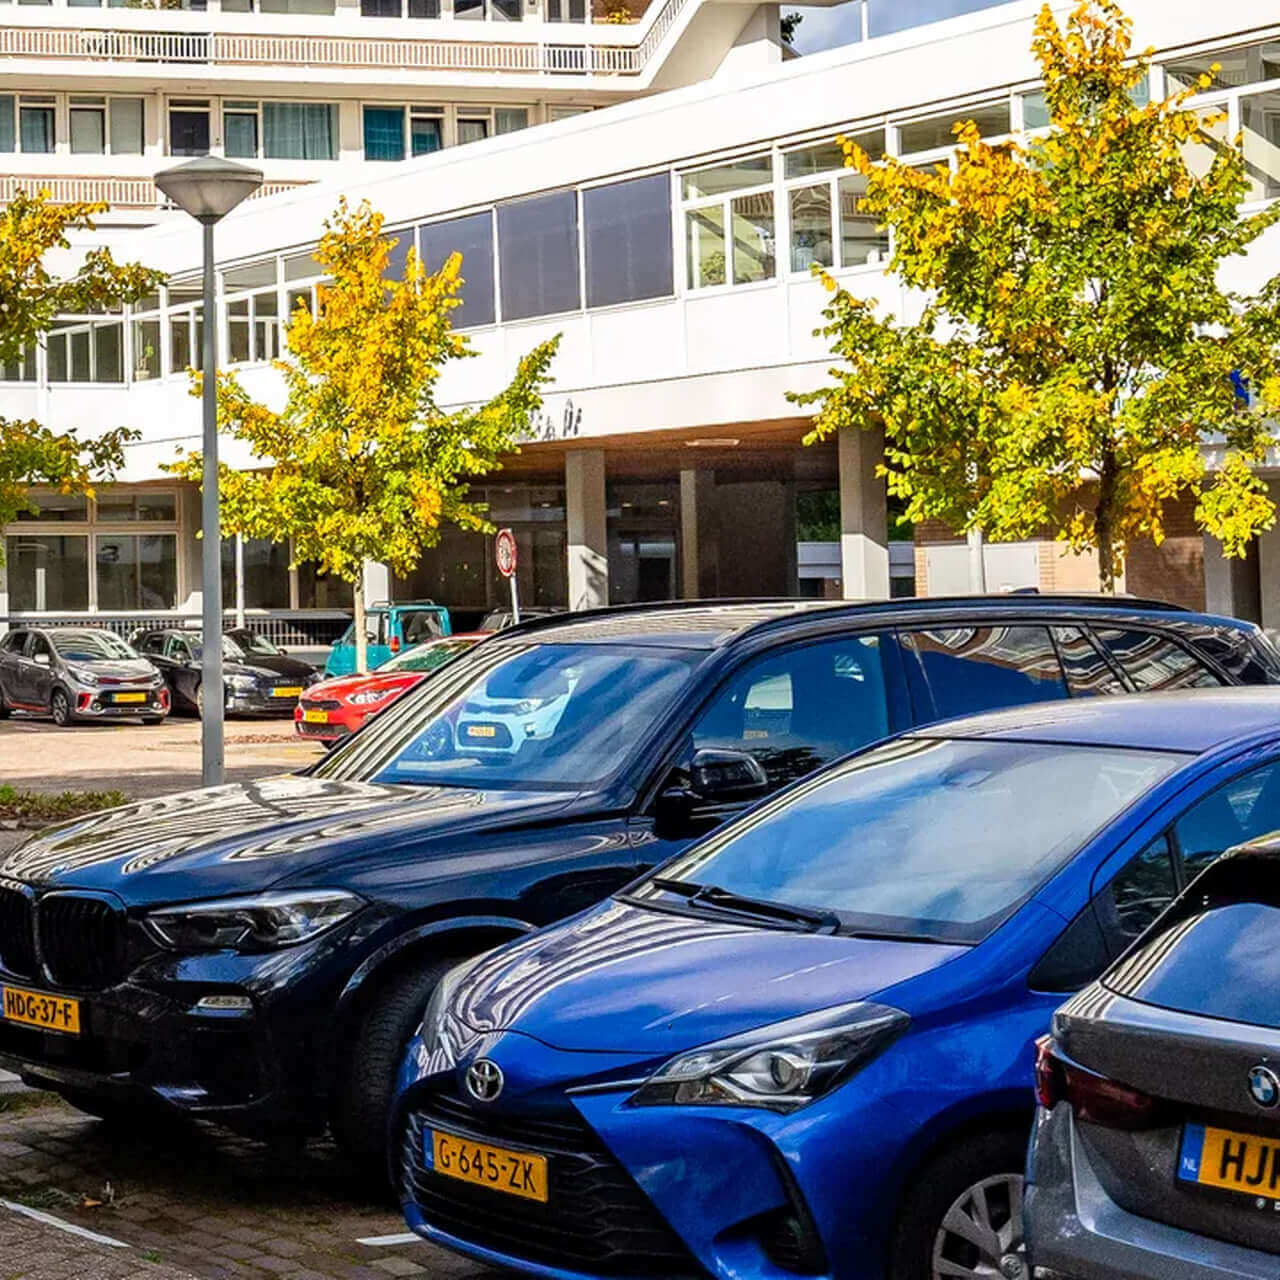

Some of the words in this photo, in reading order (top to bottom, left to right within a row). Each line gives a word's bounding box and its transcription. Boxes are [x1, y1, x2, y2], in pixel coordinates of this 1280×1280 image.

[6, 991, 72, 1027] HDG-37-F
[440, 1138, 536, 1193] G-645-ZK
[1182, 1156, 1197, 1172] NL
